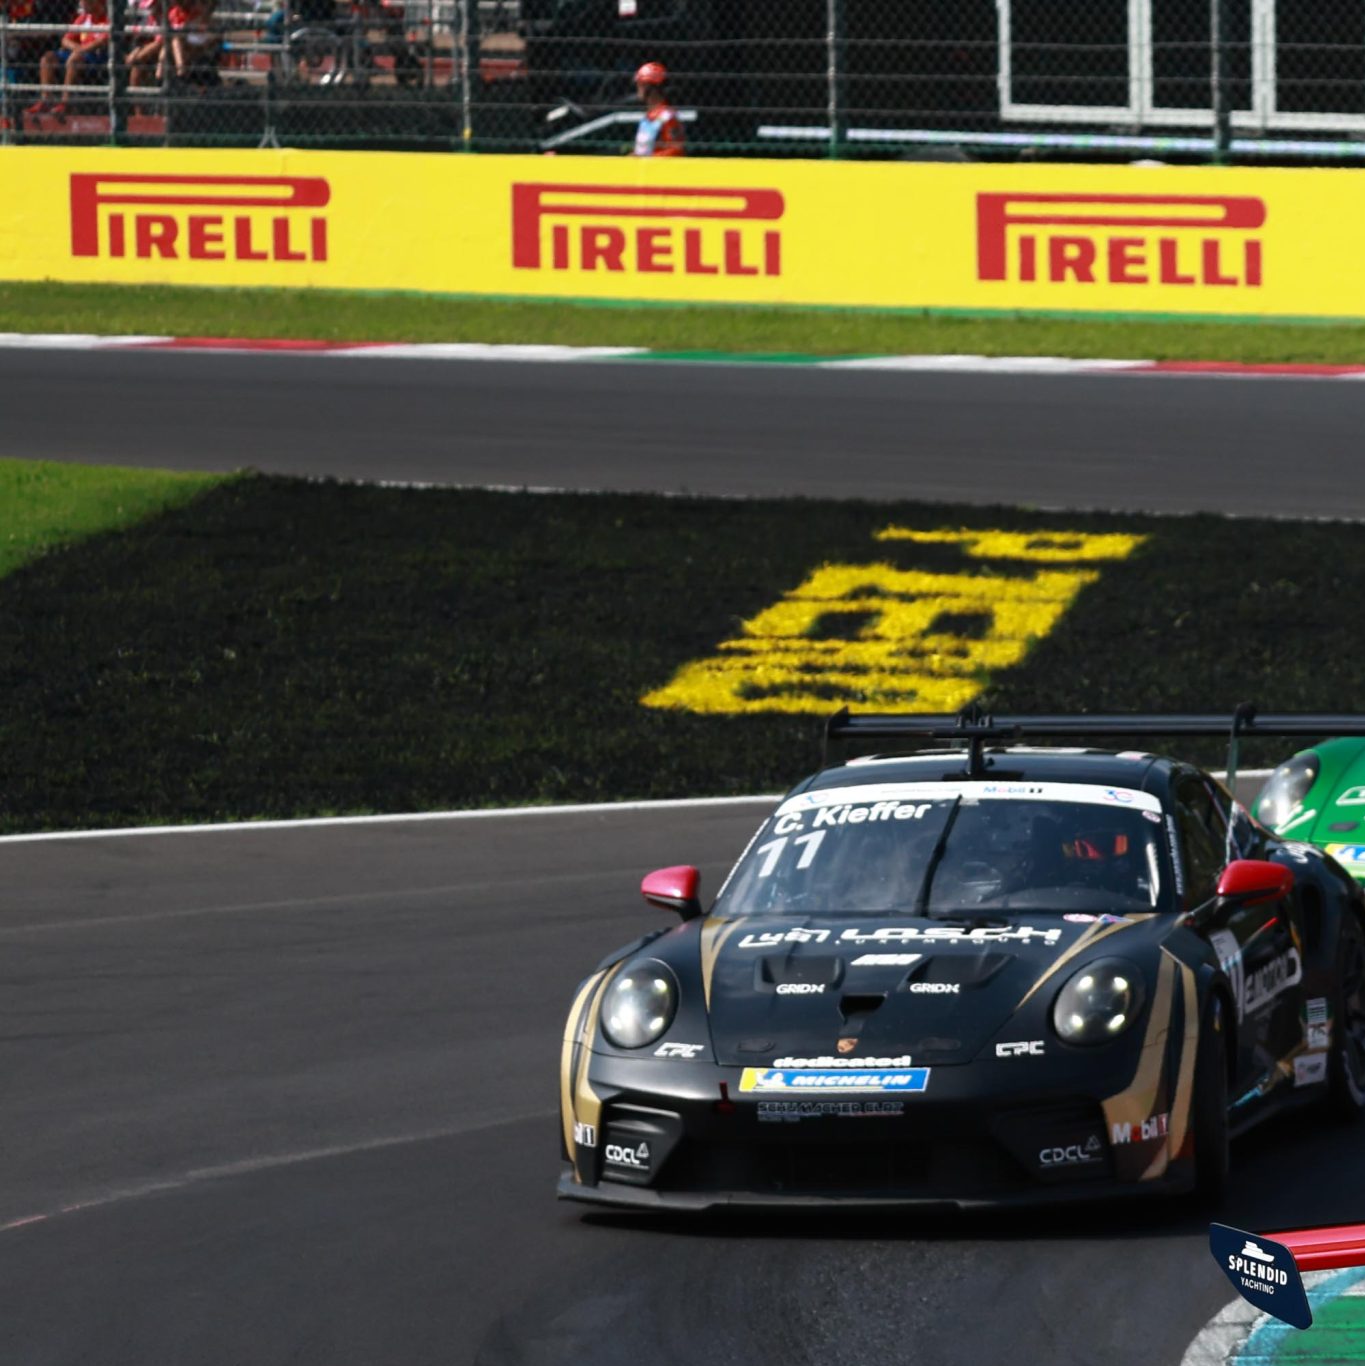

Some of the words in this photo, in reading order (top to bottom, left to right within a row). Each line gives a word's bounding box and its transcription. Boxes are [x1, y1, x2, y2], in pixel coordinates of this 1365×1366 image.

[70, 173, 331, 261] PIRELLI
[512, 182, 785, 276] PIRELLI
[976, 192, 1266, 286] PIRELLI
[774, 811, 804, 836] C.
[813, 800, 932, 829] Kieffer
[757, 830, 827, 879] 11
[773, 1055, 912, 1069] dedicated
[791, 1073, 912, 1088] MICHELIN
[1112, 1116, 1158, 1145] Mobil
[1039, 1144, 1091, 1163] CDCL
[1228, 1254, 1288, 1286] SPLENDID
[1240, 1276, 1275, 1295] YACHTING
